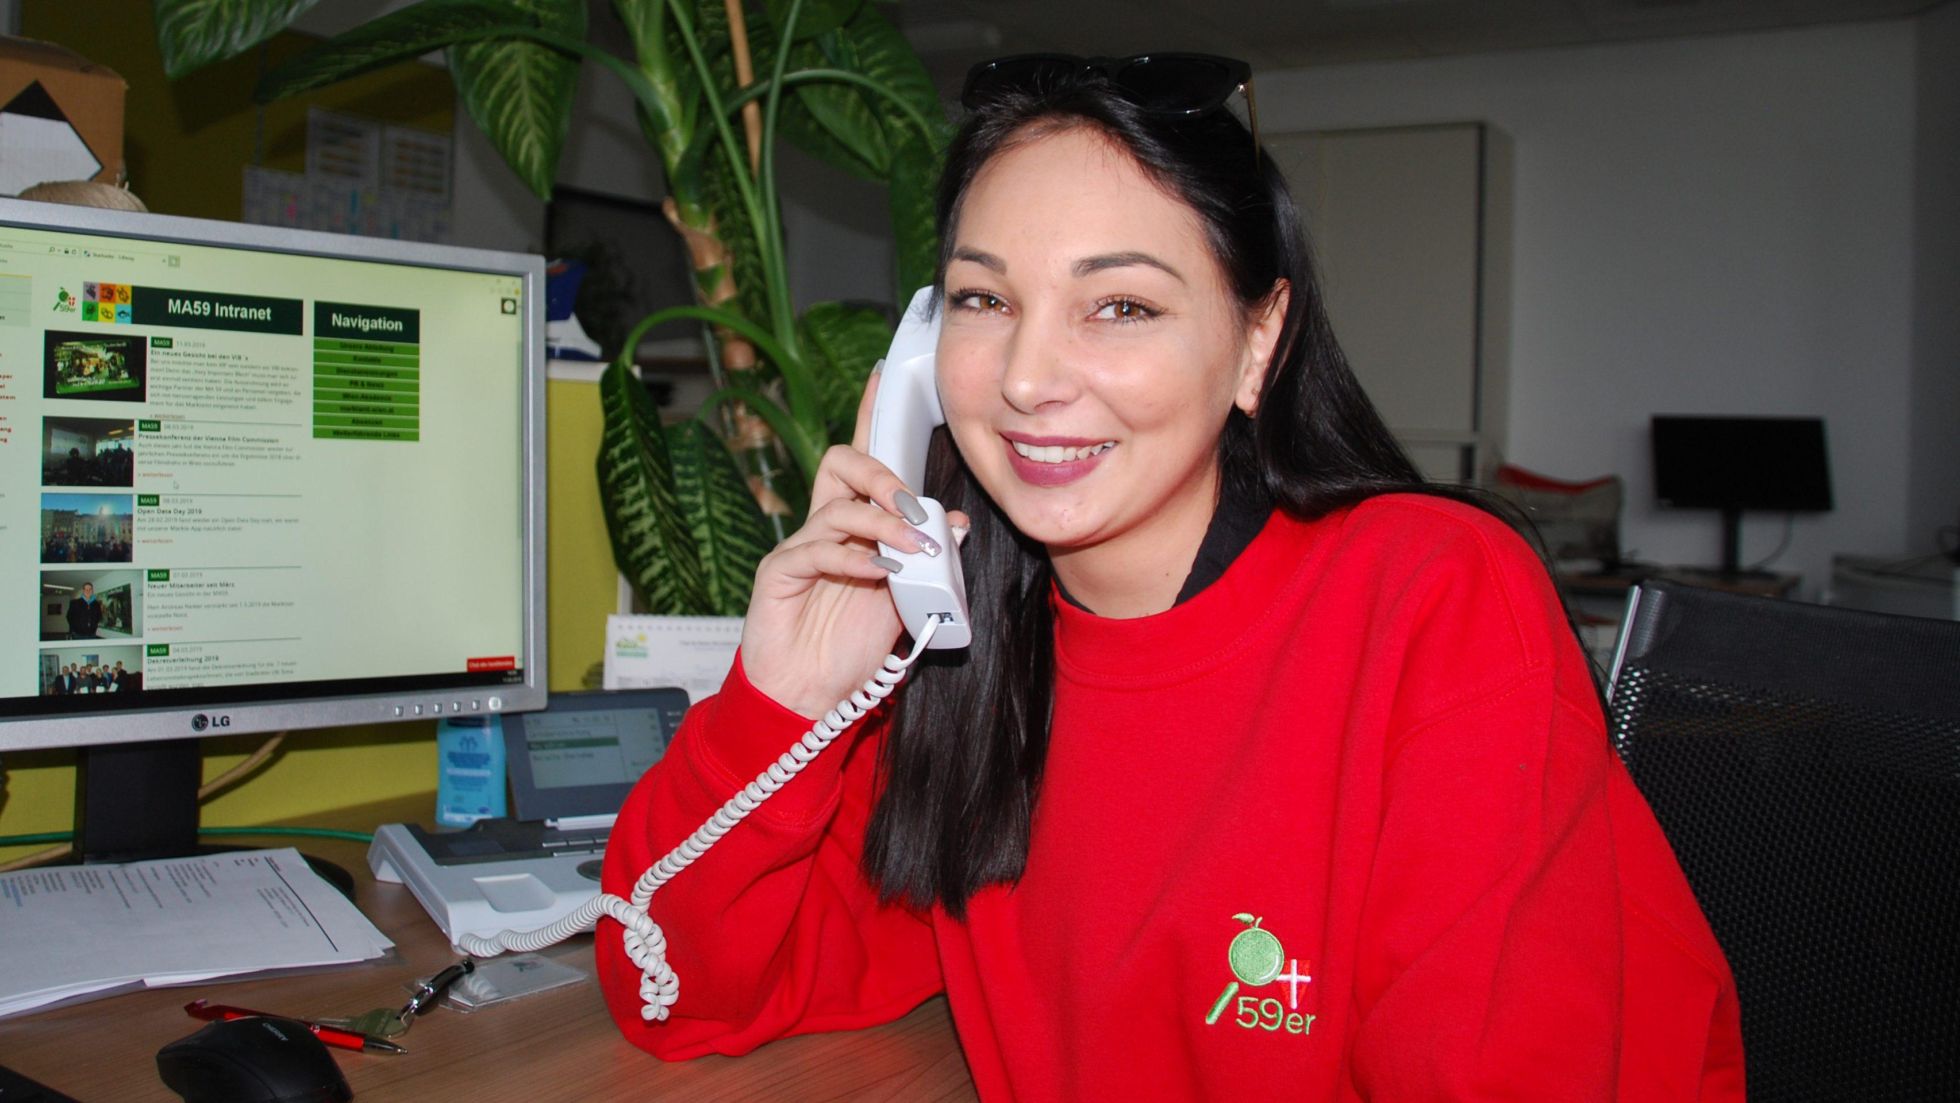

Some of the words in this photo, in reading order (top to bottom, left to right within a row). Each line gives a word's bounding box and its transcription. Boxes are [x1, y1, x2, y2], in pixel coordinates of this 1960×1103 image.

[168, 299, 211, 316] MA59
[215, 302, 272, 321] Intranet
[332, 313, 403, 332] Navigation
[212, 715, 231, 727] LG
[1236, 996, 1316, 1035] 59er
